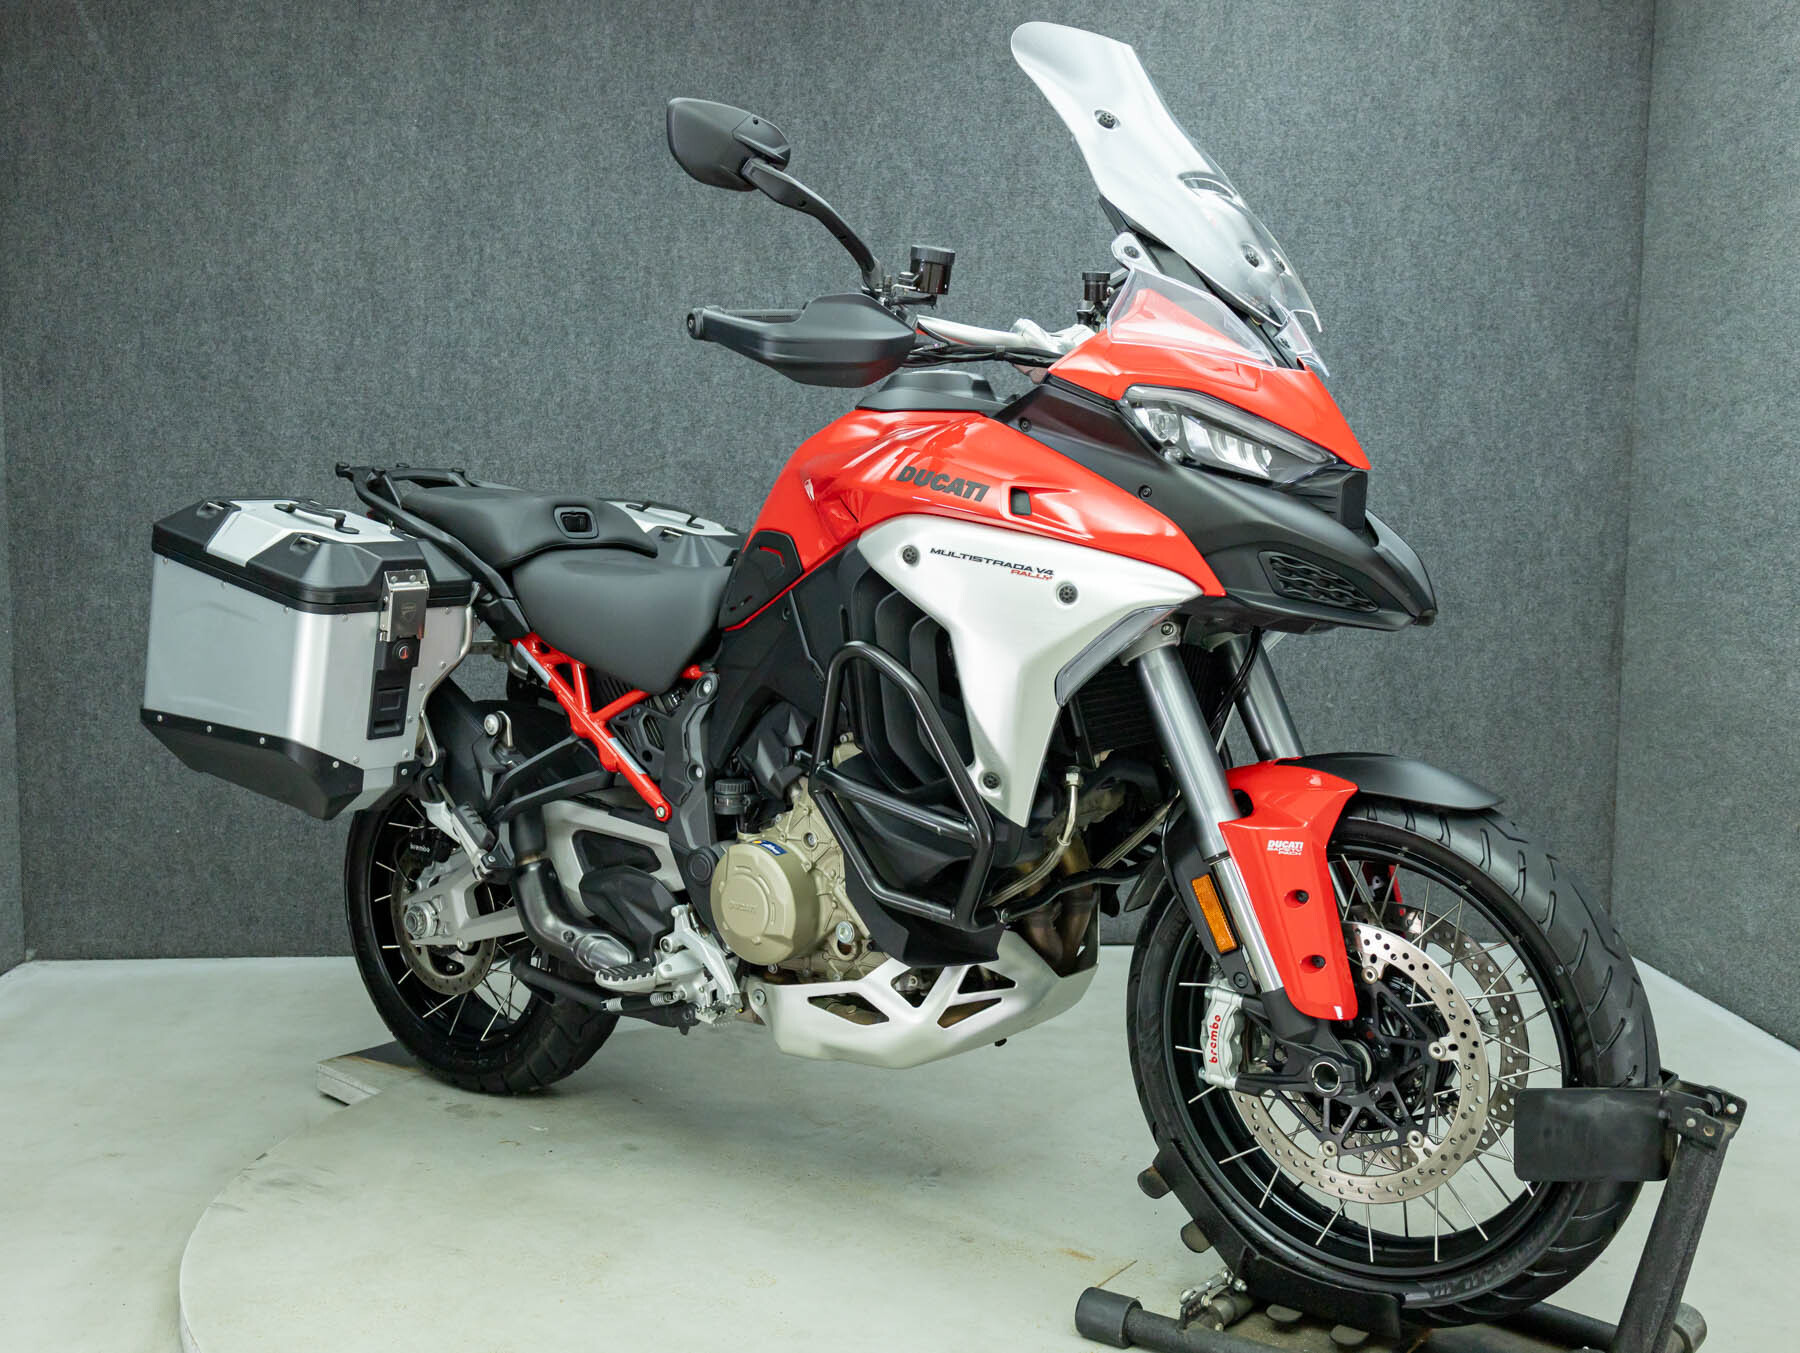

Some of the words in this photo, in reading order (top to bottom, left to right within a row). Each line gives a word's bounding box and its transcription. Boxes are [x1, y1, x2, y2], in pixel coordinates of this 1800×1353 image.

[896, 465, 990, 502] DUCATI
[930, 548, 1033, 572] MULTISTRADA
[1036, 567, 1054, 576] V4
[1010, 569, 1053, 580] RALLY
[1267, 840, 1304, 849] DUCATI
[1209, 1015, 1221, 1064] brembo
